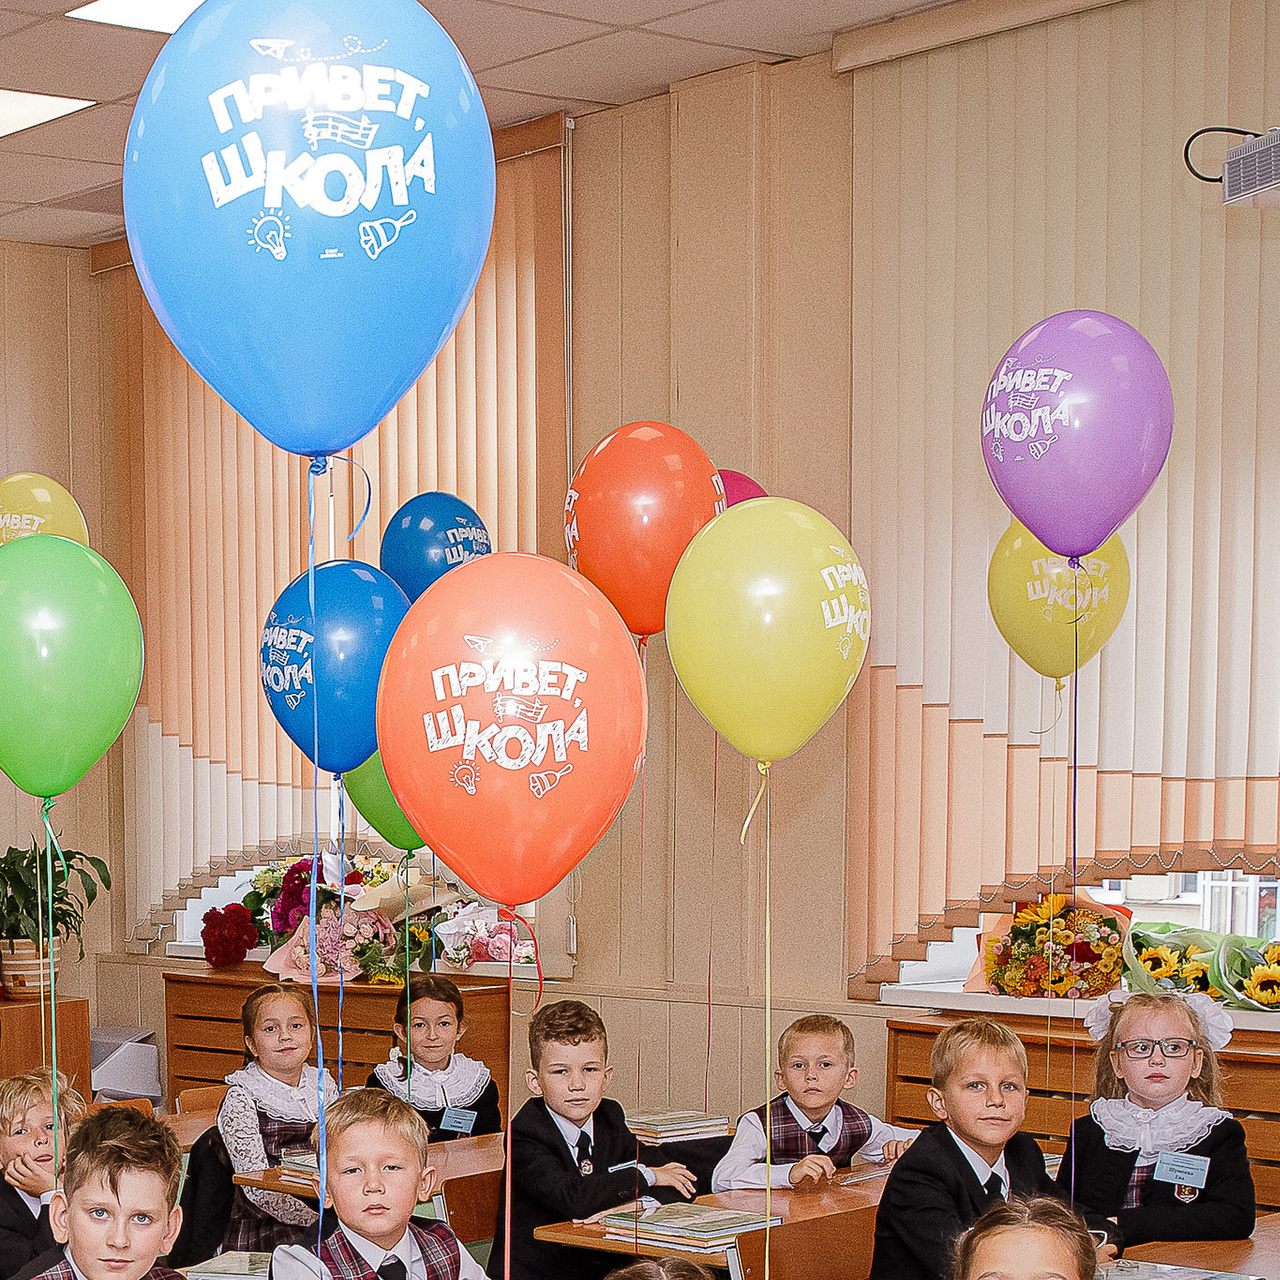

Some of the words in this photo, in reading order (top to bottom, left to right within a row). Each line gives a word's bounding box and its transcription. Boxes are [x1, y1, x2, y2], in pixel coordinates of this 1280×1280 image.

[208, 62, 430, 133] ПРИВЕТ,
[201, 131, 436, 217] ШКОЛА
[986, 368, 1073, 403] ПРИВЕТ,
[983, 397, 1070, 442] ШКОЛА
[445, 527, 490, 545] ПРИВЕ
[1026, 577, 1109, 610] ШКОЛА
[821, 593, 869, 641] ШКО
[261, 626, 315, 659] РИВЕТ,
[260, 657, 314, 693] КОЛА
[431, 660, 588, 709] ПРИВЕТ,
[422, 704, 589, 771] ШКОЛА
